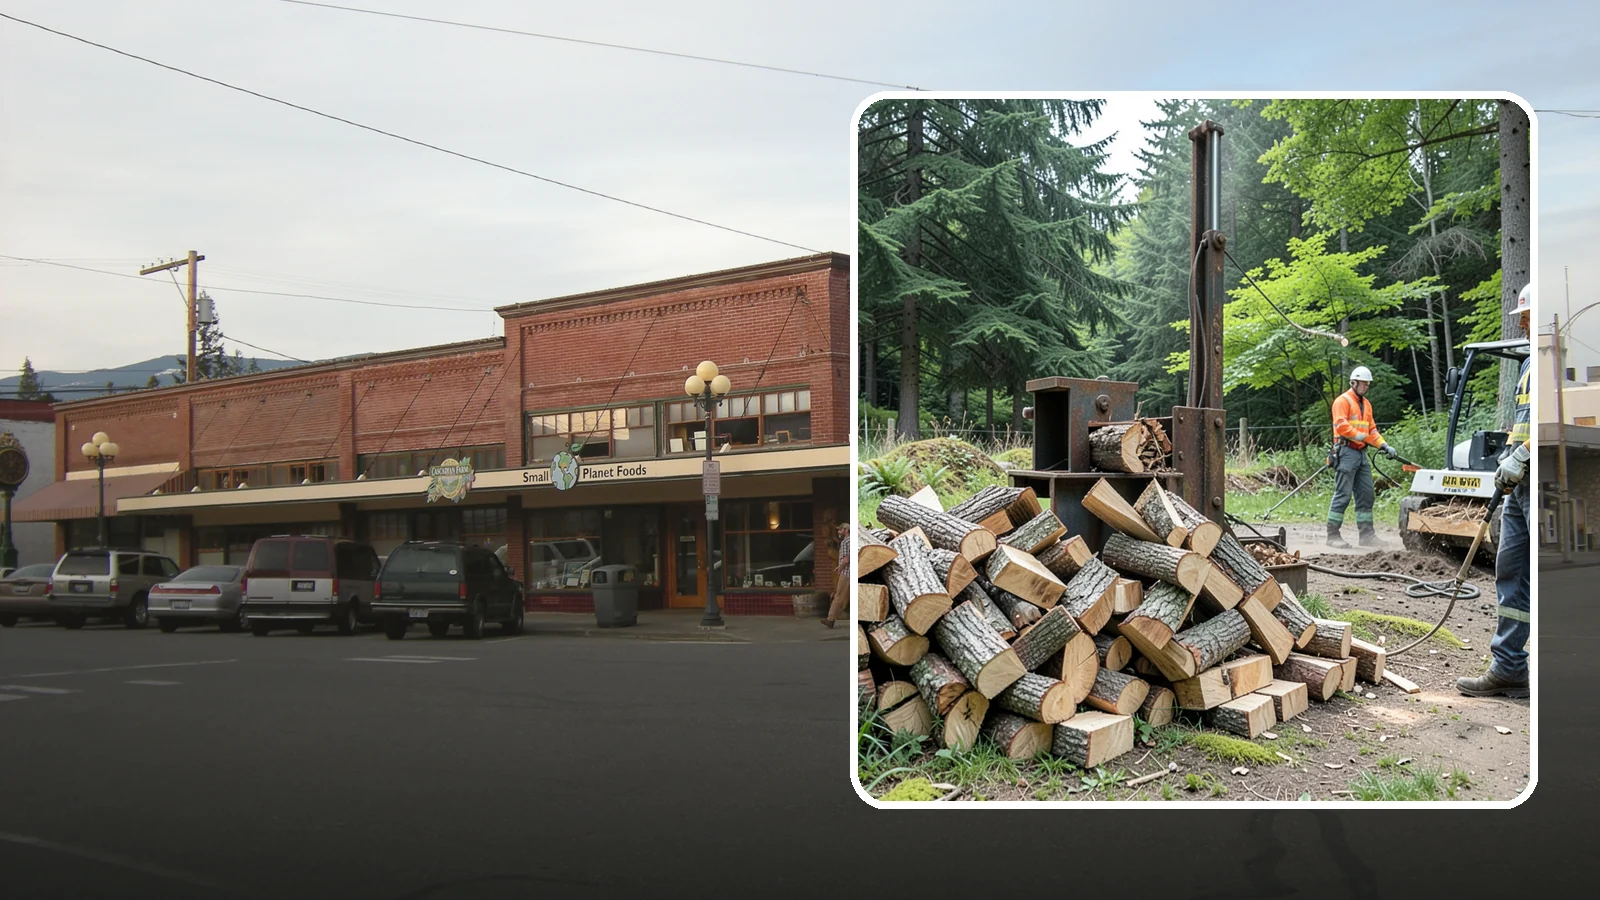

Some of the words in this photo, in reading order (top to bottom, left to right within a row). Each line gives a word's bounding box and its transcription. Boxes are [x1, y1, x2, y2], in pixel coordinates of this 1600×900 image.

[523, 471, 549, 483] Small
[583, 467, 614, 479] Planet
[617, 464, 647, 477] Foods
